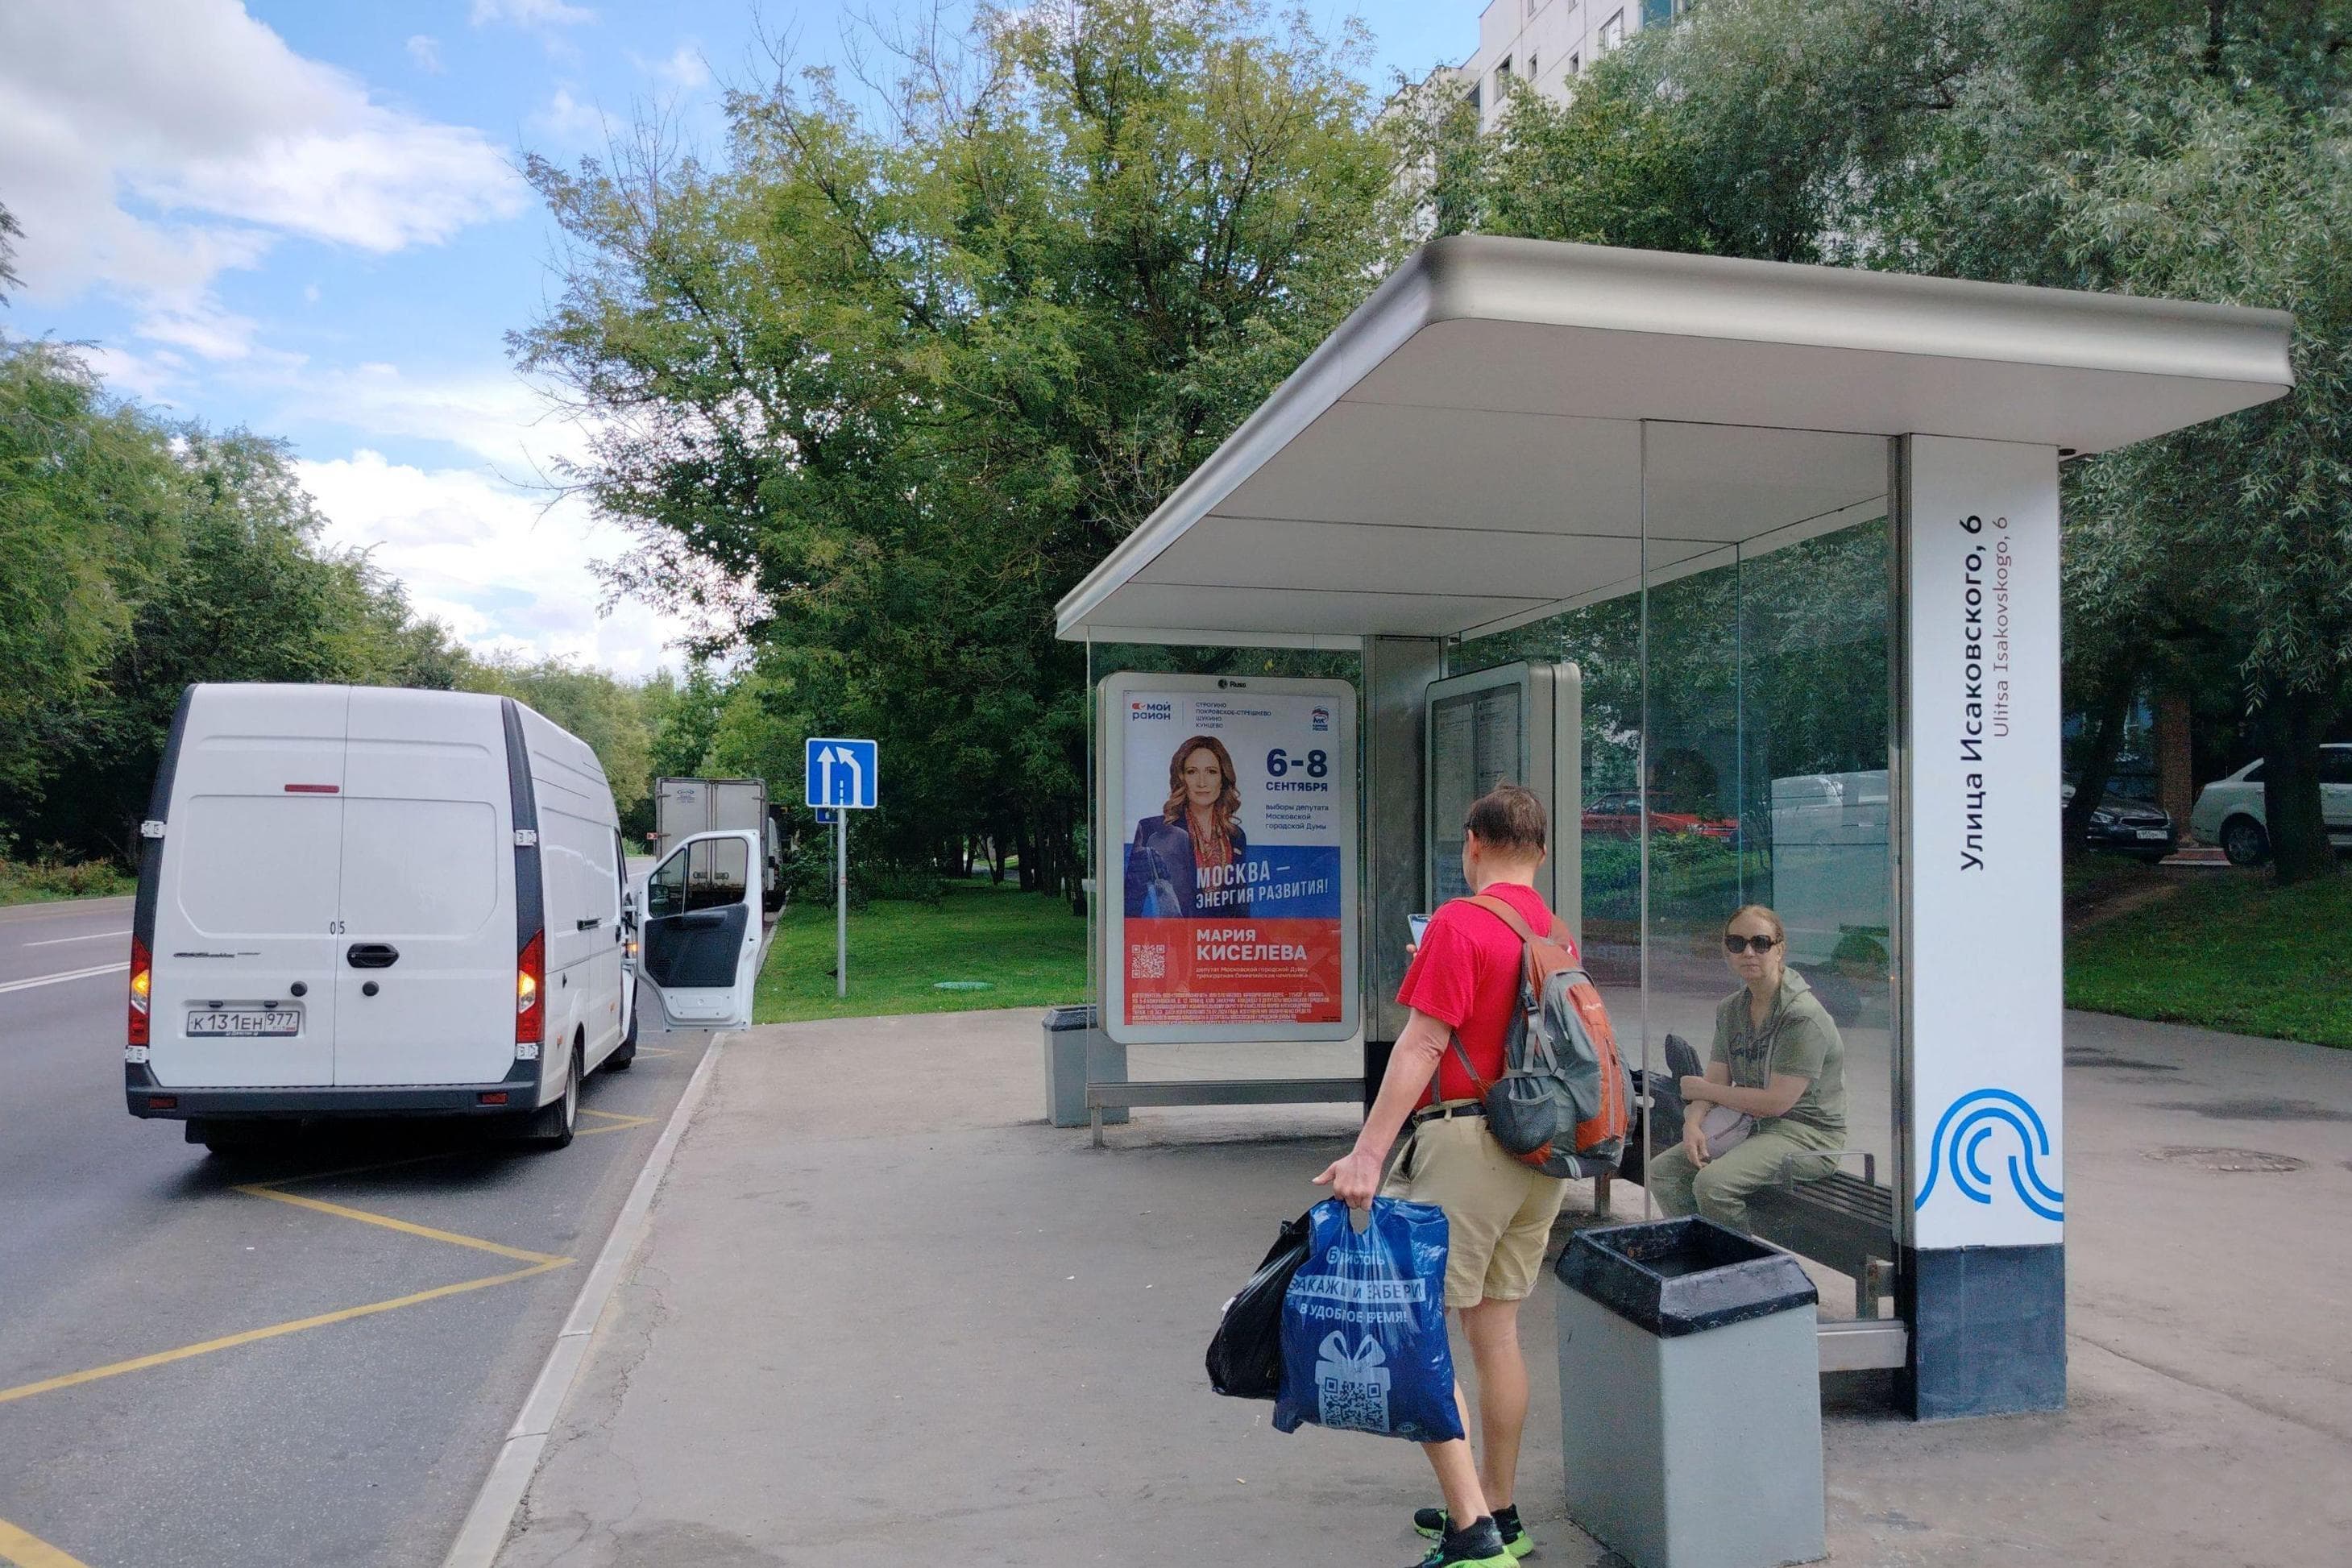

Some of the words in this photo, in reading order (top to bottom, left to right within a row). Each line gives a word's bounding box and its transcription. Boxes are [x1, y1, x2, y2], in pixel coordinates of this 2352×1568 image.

[1960, 514, 1982, 534] 6
[1993, 516, 2008, 529] 6
[1993, 535, 2011, 670] Isakovskogo,
[1960, 545, 1987, 761] Исаковского,
[1147, 700, 1171, 711] мой
[1993, 679, 2009, 737] Ulitsa
[1266, 782, 1328, 792] СЕНТЯБРЯ
[1265, 804, 1294, 812] выборы
[1296, 804, 1329, 813] депутата
[1265, 812, 1312, 820] Московской
[1265, 821, 1304, 831] городской
[1305, 822, 1327, 831] Думы
[1960, 773, 1986, 871] Улица
[1197, 861, 1270, 889] МОСКВА
[1196, 887, 1255, 910] ЭНЕРГИЯ
[1259, 878, 1329, 903] РАЗВИТИЯ!
[1197, 928, 1256, 942] МАРИЯ
[1197, 944, 1307, 961] КИСЕЛЕВА
[267, 1013, 293, 1026] 977
[1299, 1303, 1308, 1314] В
[1309, 1305, 1363, 1323] УДОБОЕ
